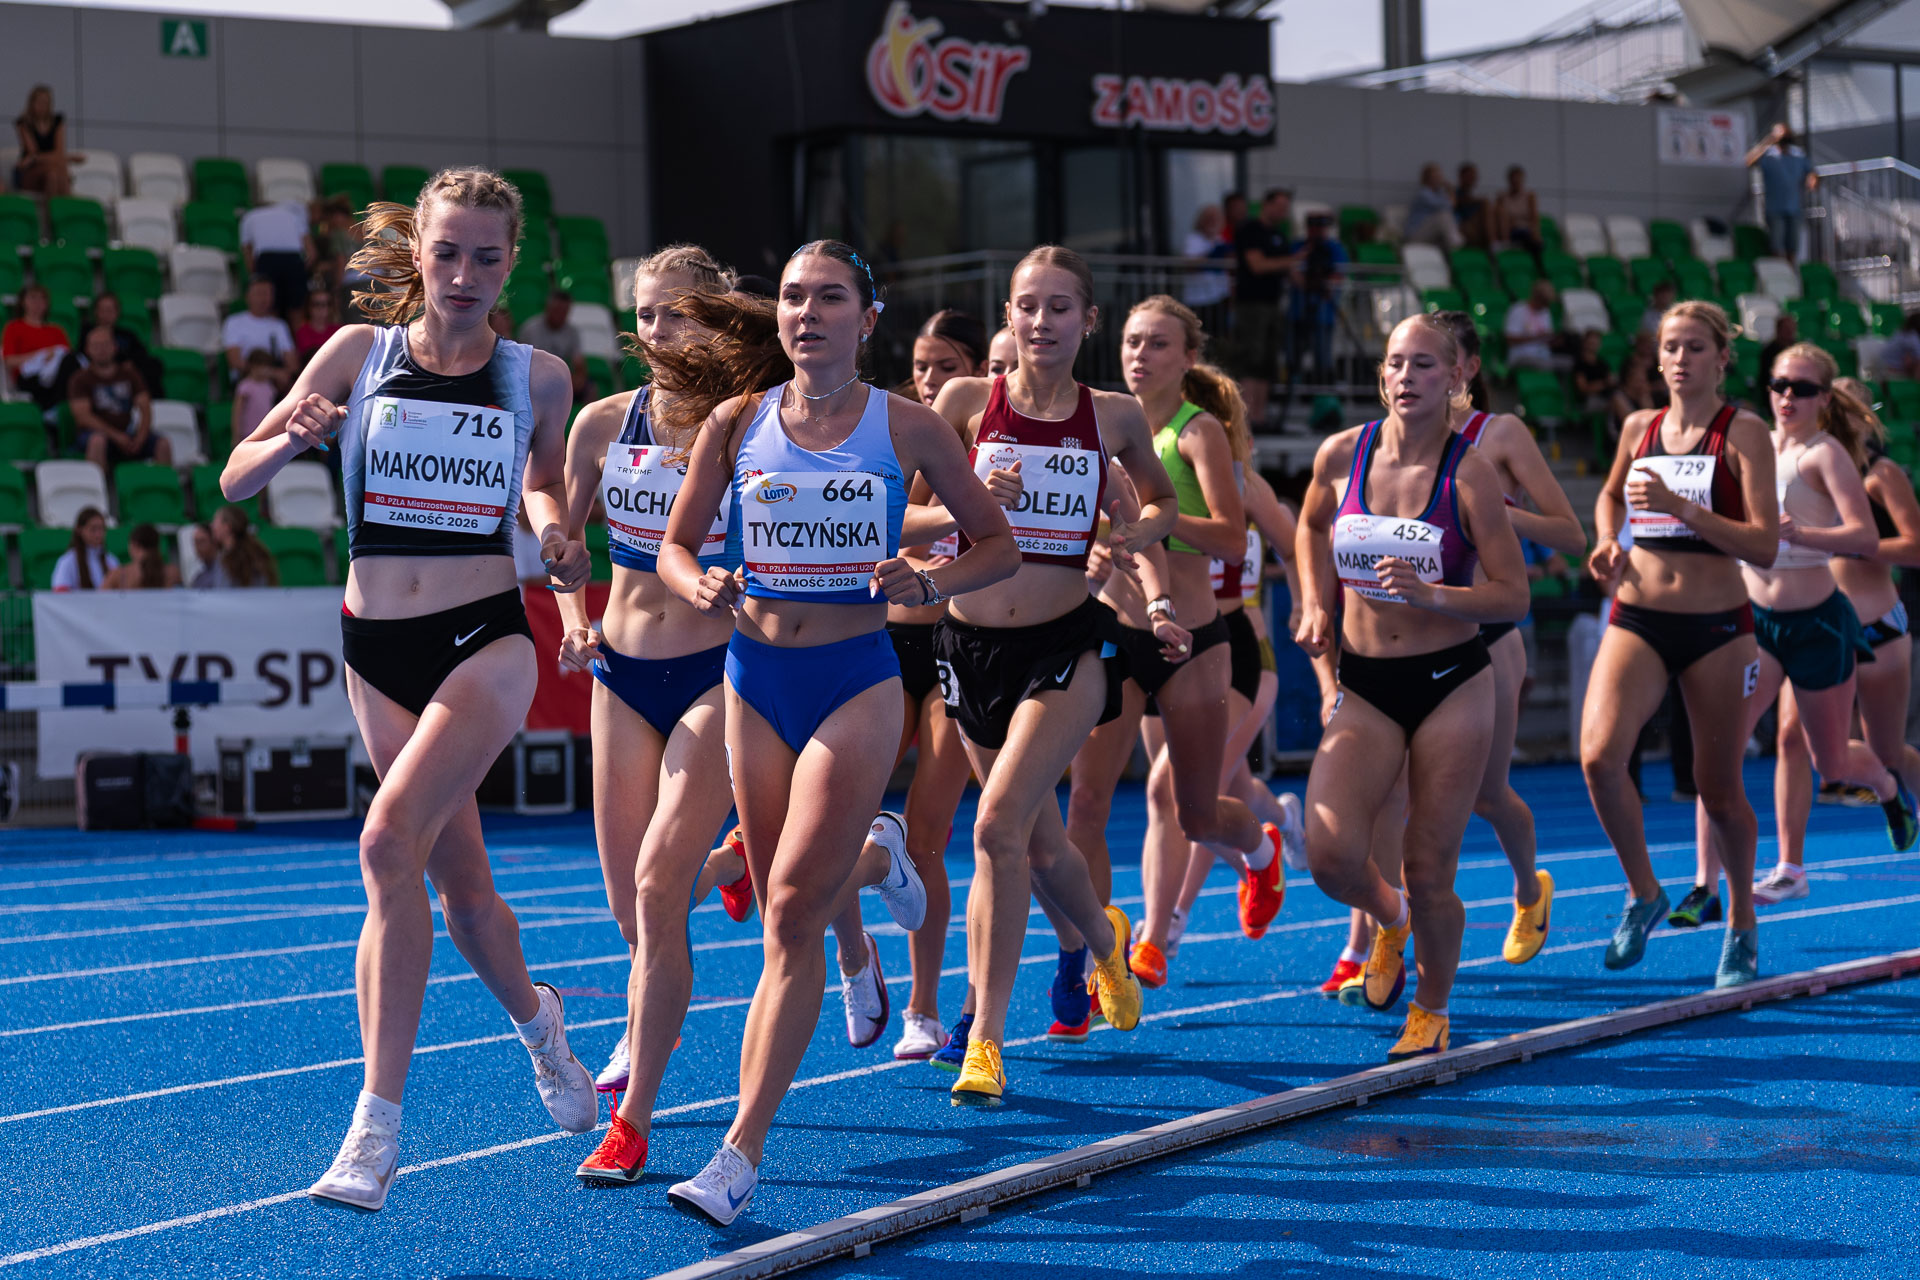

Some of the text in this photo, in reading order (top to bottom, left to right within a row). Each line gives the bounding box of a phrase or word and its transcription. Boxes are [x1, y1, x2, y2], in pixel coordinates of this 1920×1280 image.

[170, 21, 200, 56] A
[1093, 73, 1273, 135] ZAMOŚĆ
[452, 411, 503, 439] 716
[371, 449, 506, 489] MAKOWSKA
[617, 467, 652, 476] TRYUMF
[1045, 454, 1089, 476] 403
[1674, 461, 1705, 476] 729
[763, 487, 790, 500] LOTTO
[823, 479, 873, 502] 664
[375, 495, 496, 515] 80. PZLA Mistrzostwa Polski U20
[1012, 488, 1089, 517] OLEJA
[389, 511, 479, 529] ZAMOŚĆ 2026
[624, 526, 638, 535] PZLA
[748, 517, 881, 548] TYCZYŃSKA
[1050, 531, 1070, 539] Polski
[1393, 524, 1432, 542] 452
[628, 537, 661, 552] ZAMOŚ
[1016, 539, 1069, 552] OŚĆ 2026
[756, 564, 768, 572] 80.
[836, 565, 858, 573] Polski
[859, 564, 875, 572] U20
[1338, 552, 1439, 574] MARSSKA
[772, 576, 858, 587] ZAMOŚĆ 2026
[256, 650, 348, 707] SP
[1749, 664, 1758, 691] 5
